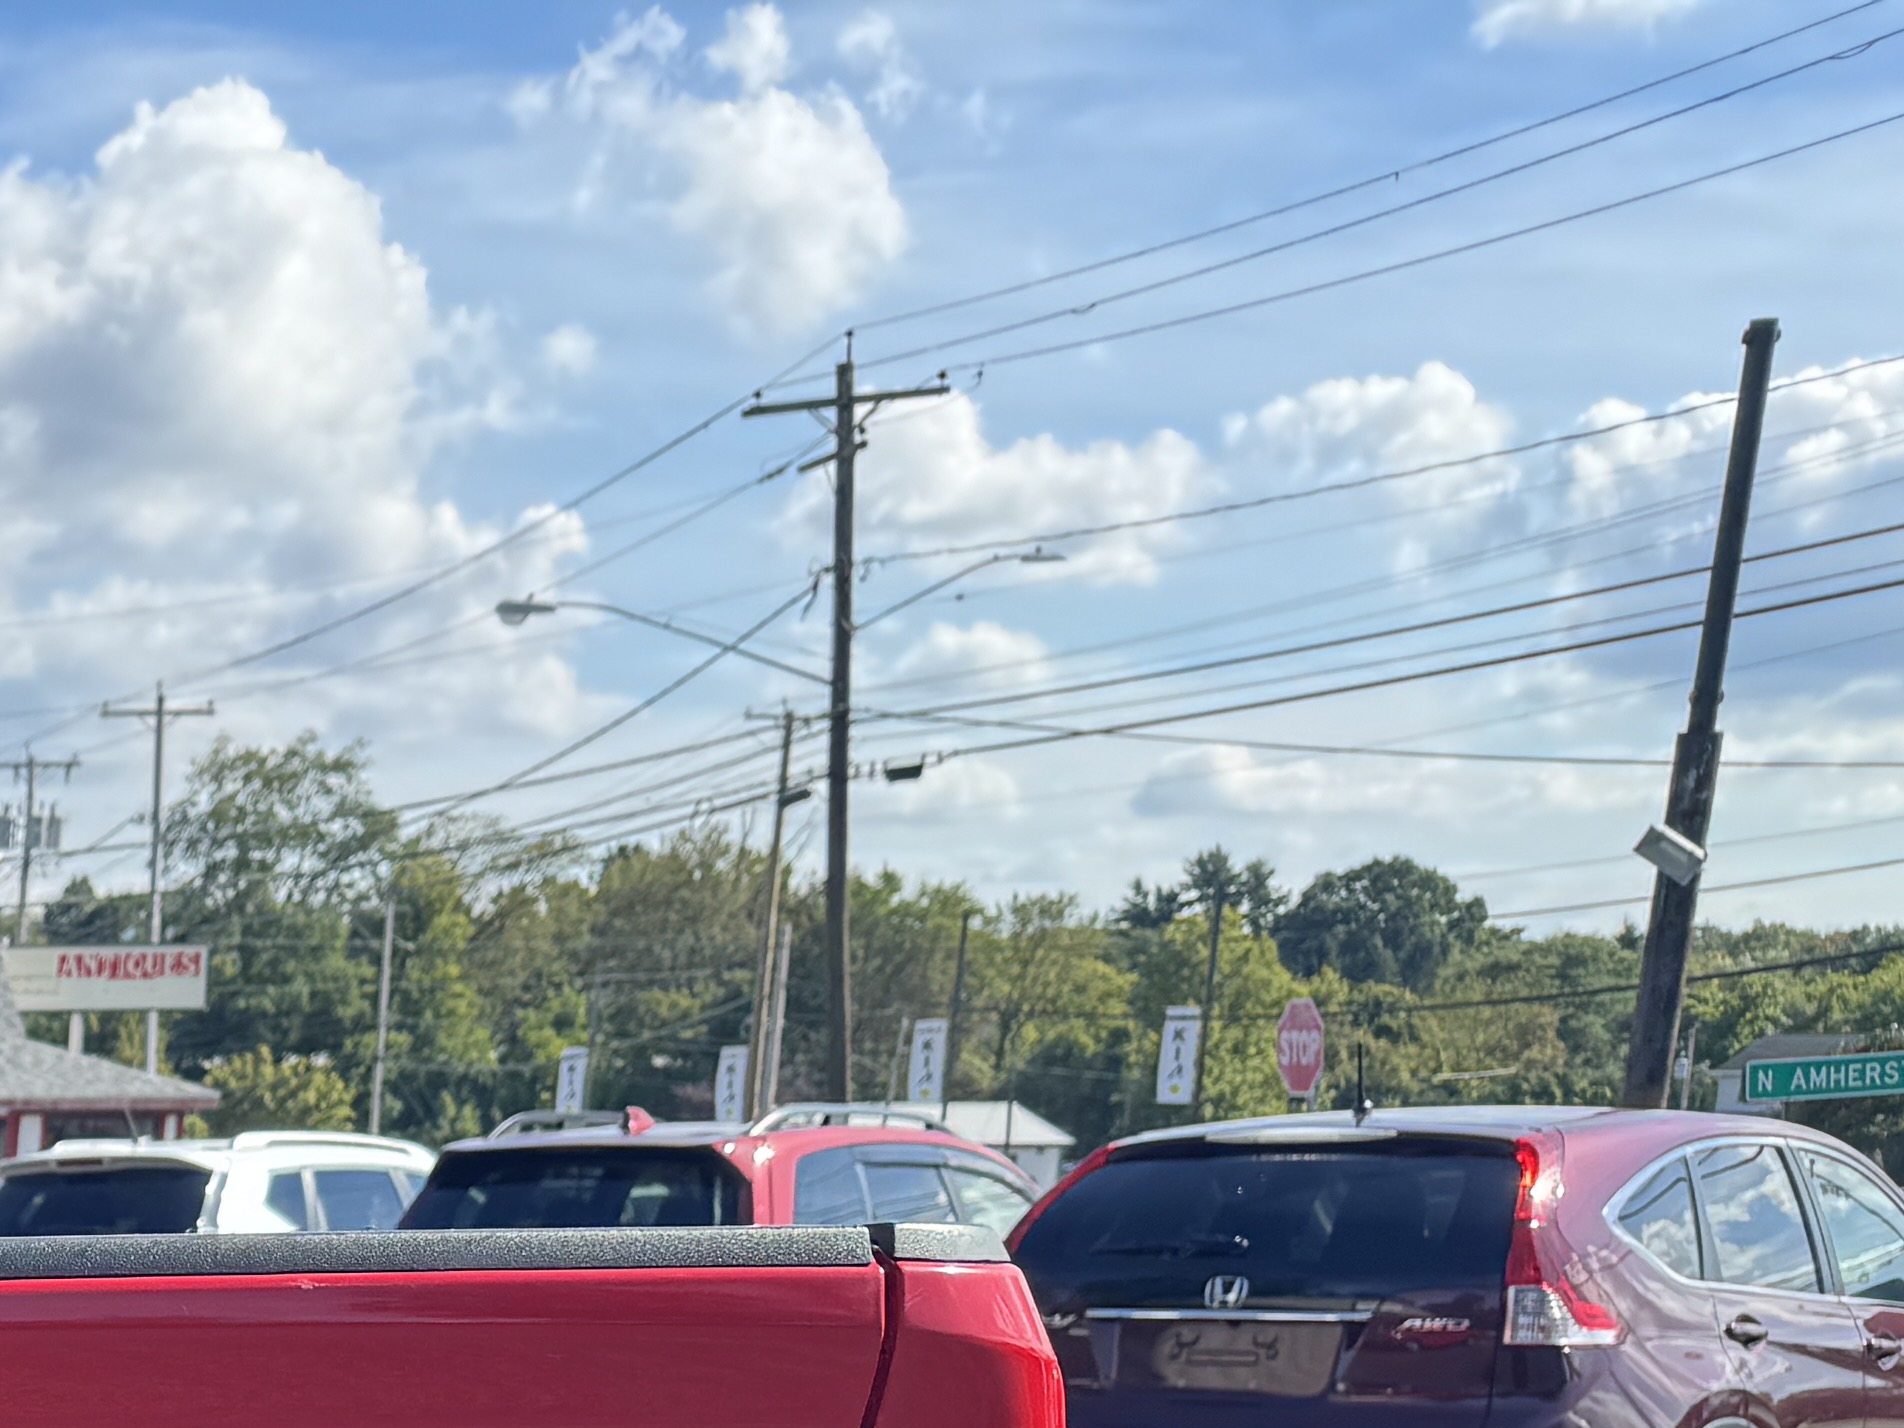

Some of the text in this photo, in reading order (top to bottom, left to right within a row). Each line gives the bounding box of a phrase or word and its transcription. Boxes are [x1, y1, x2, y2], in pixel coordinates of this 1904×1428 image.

[1279, 1028, 1321, 1067] STOP
[1758, 1060, 1904, 1093] N AMHERS
